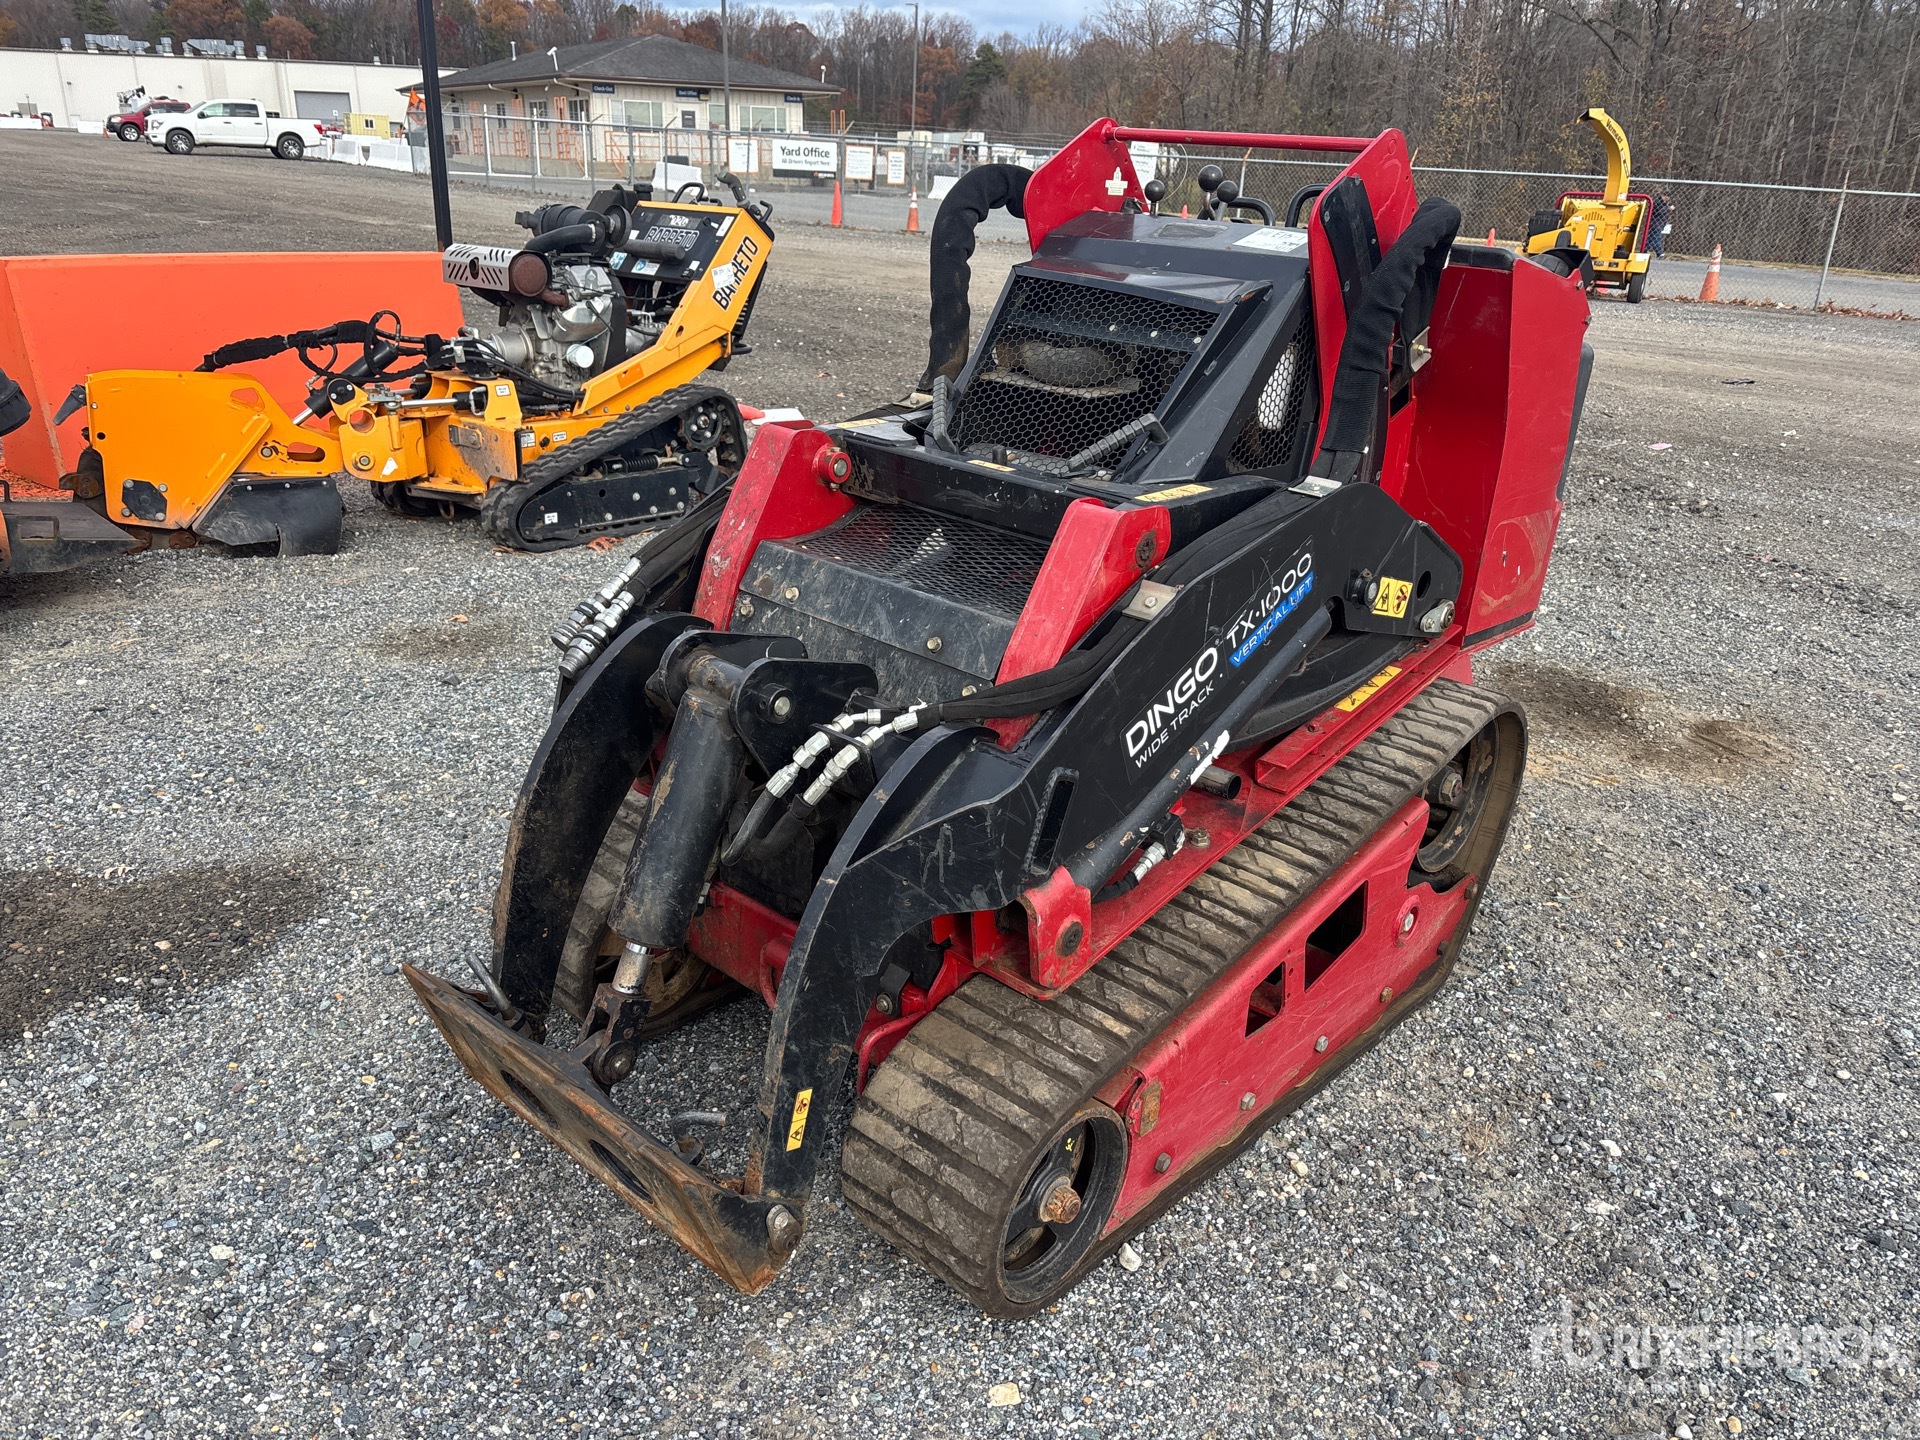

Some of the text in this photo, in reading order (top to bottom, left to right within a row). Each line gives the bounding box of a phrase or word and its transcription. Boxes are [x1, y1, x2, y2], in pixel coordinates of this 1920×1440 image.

[780, 146, 830, 158] Yard Office
[1126, 648, 1217, 757] DINGO
[1135, 577, 1311, 768] WIDE TRACK VERTICAL LIFT
